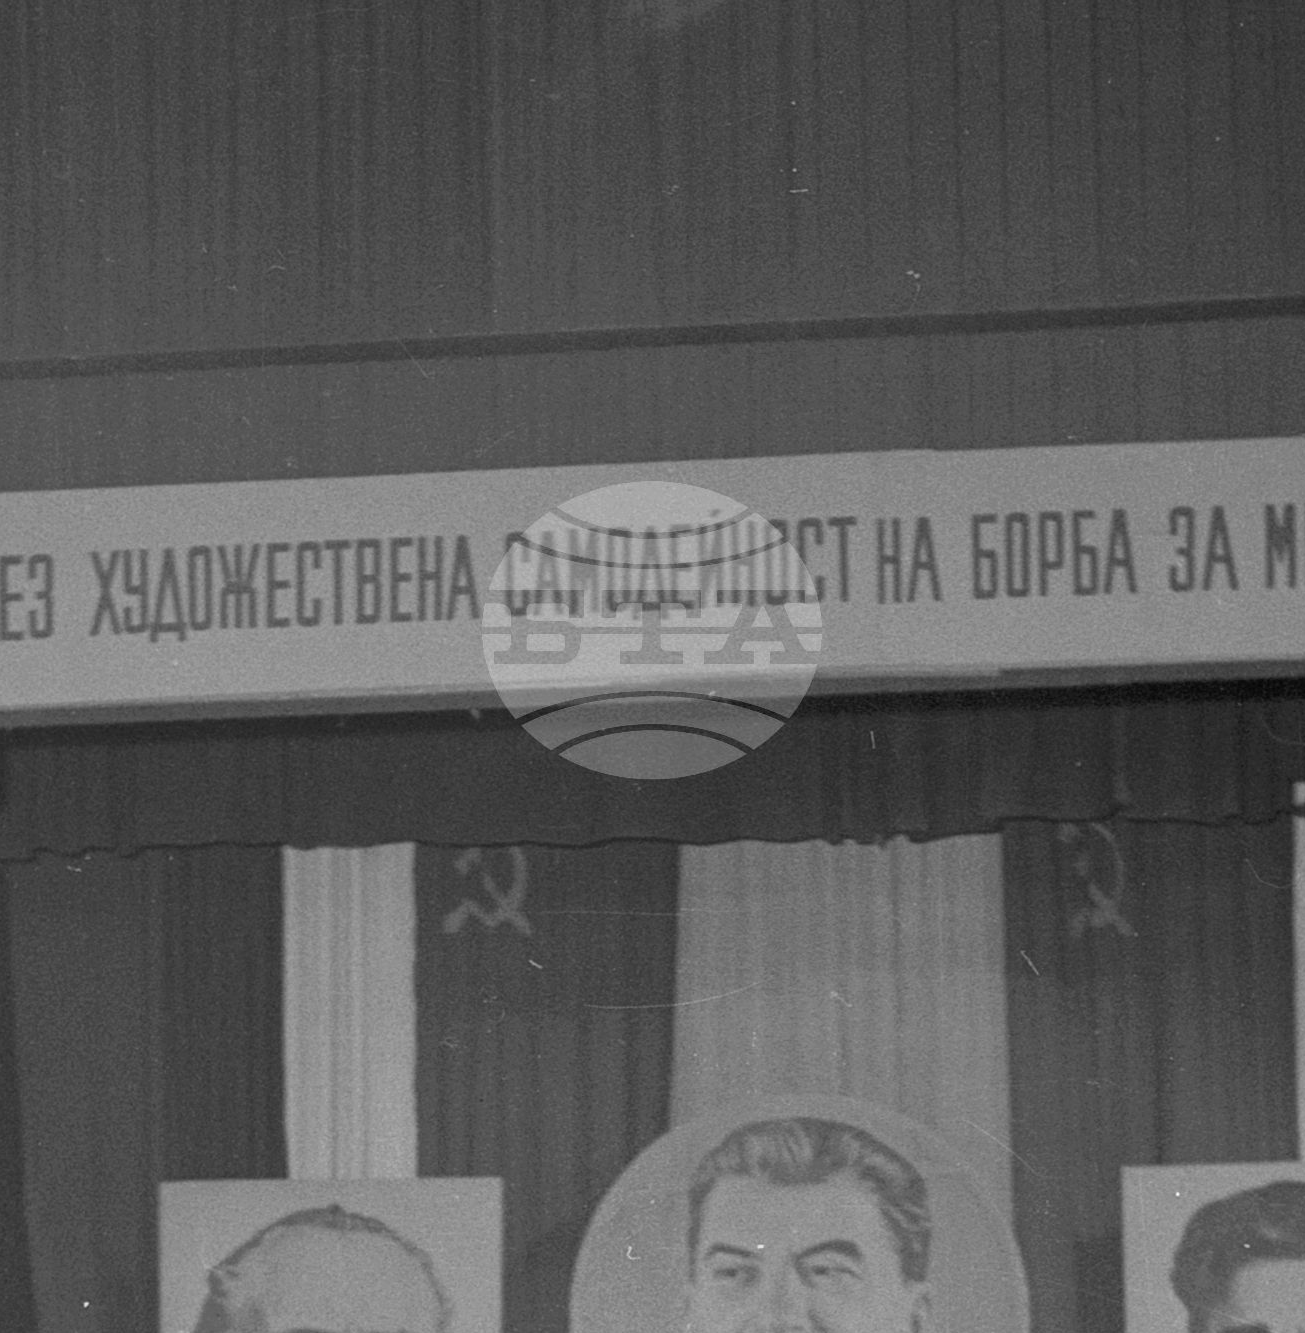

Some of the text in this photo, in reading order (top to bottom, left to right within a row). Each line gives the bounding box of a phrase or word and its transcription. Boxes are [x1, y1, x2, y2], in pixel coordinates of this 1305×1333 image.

[90, 534, 481, 643] ХУДОЖЕСТВЕНА
[876, 516, 942, 605] НА
[971, 508, 1138, 600] БОРБА
[1168, 504, 1239, 593] ЗА
